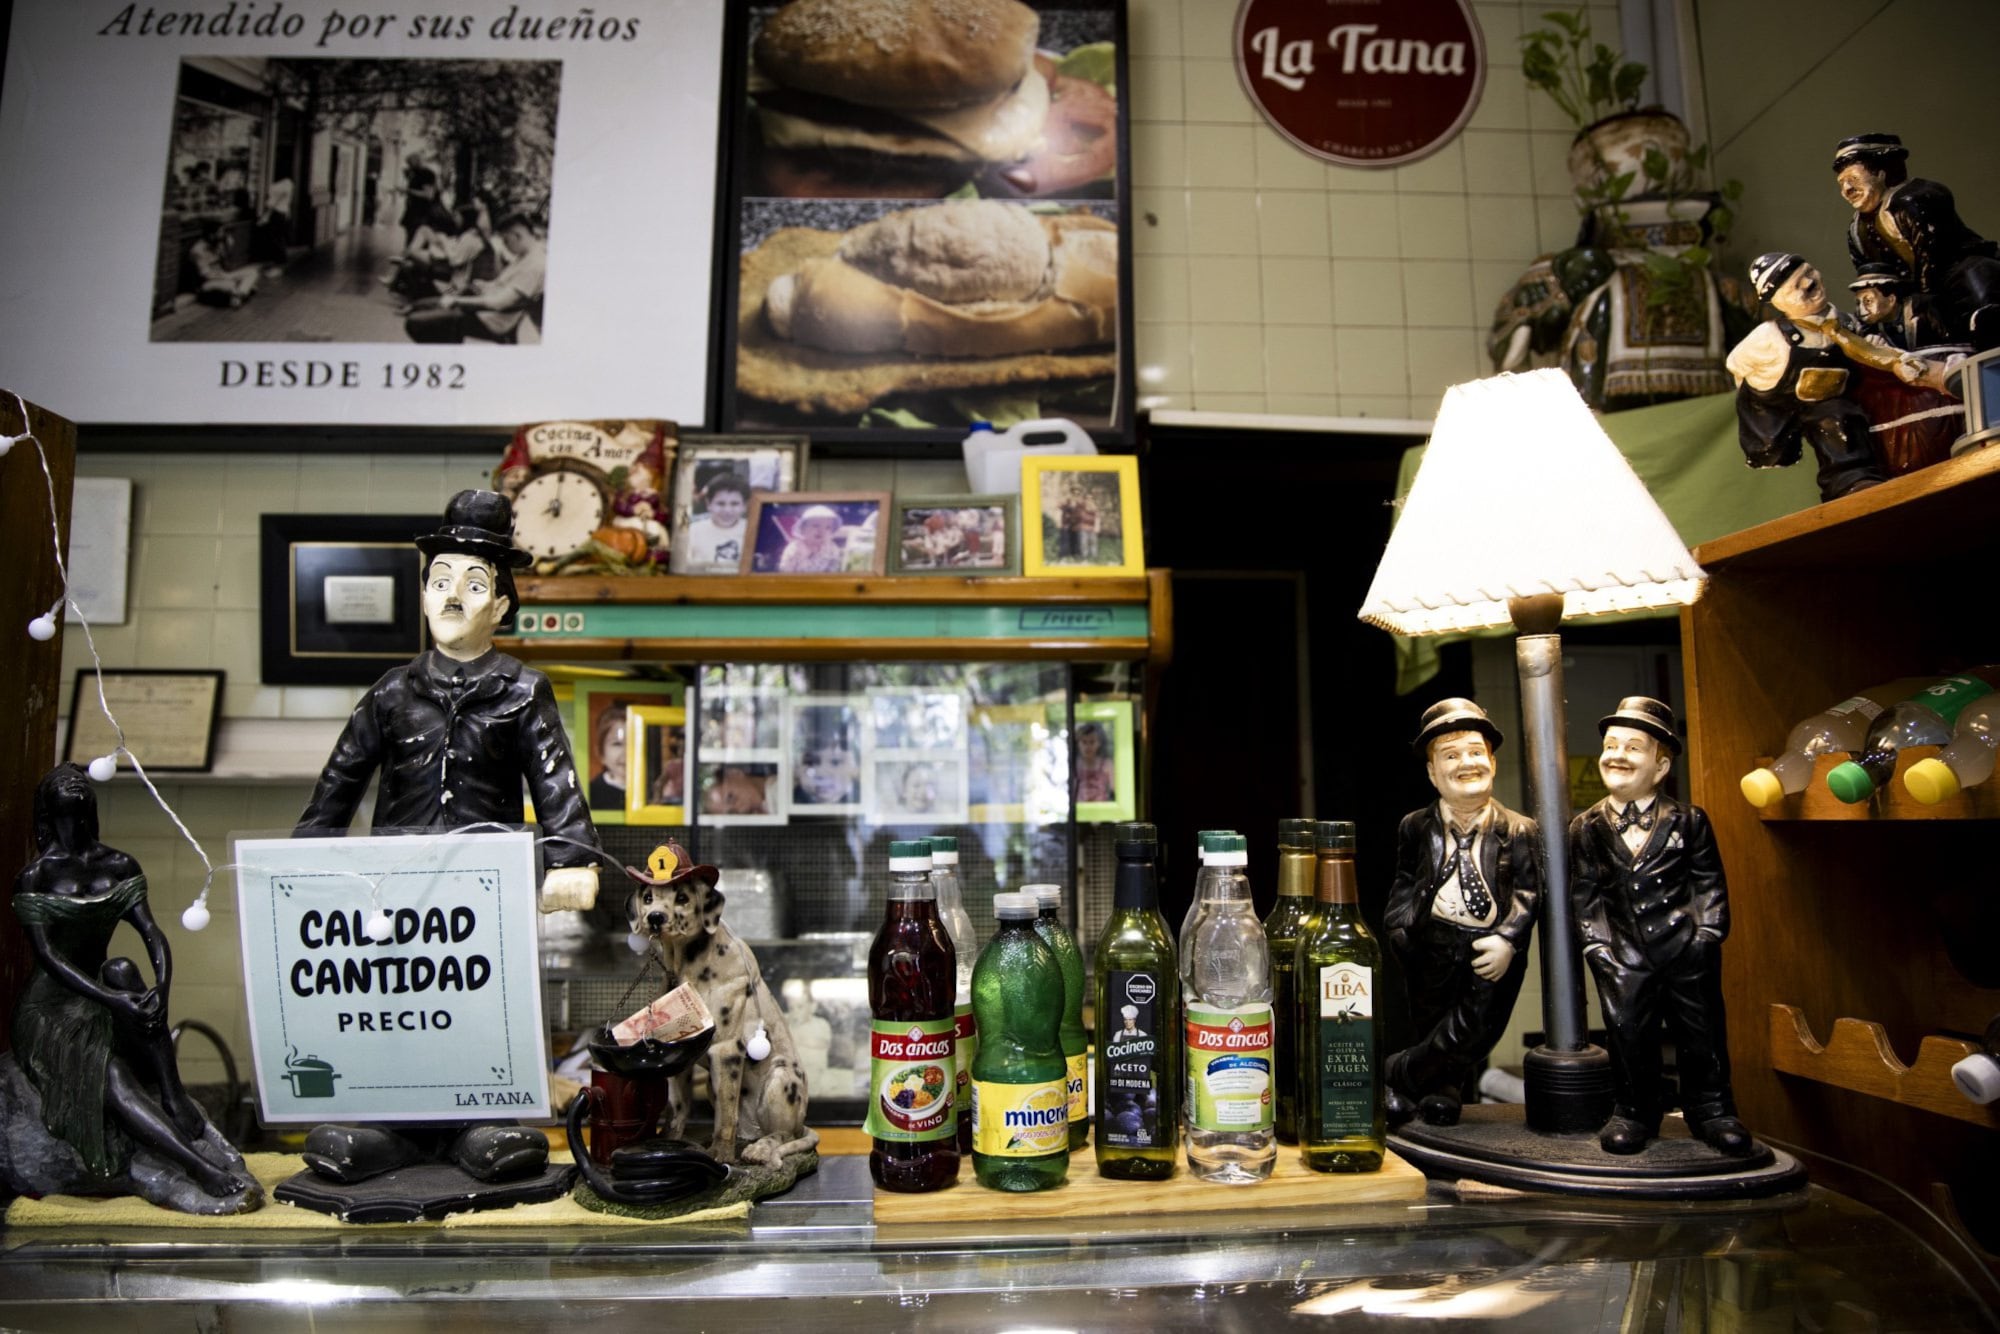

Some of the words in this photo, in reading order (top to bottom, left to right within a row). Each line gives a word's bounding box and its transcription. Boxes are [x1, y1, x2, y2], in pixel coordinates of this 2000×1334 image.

[97, 2, 305, 37] Atendido
[315, 9, 396, 47] por
[408, 13, 475, 40] sus
[489, 5, 641, 41] dueños
[1251, 26, 1315, 91] La
[1327, 23, 1466, 76] Tana
[219, 360, 361, 388] DESDE
[382, 363, 466, 389] 1982
[533, 428, 592, 443] Cocina
[658, 858, 665, 870] 1
[290, 954, 491, 998] CANTIDAD
[1324, 981, 1368, 1000] LIRA
[338, 1009, 452, 1032] PRECIO
[1106, 1040, 1155, 1057] Cocinero
[1327, 1054, 1366, 1063] EXTRA
[1114, 1063, 1147, 1072] ACETO
[1325, 1064, 1369, 1073] VIRGEN
[1125, 1080, 1151, 1089] MODENA
[455, 1093, 480, 1106] LA
[481, 1092, 535, 1105] TANA
[917, 1115, 943, 1129] VINO
